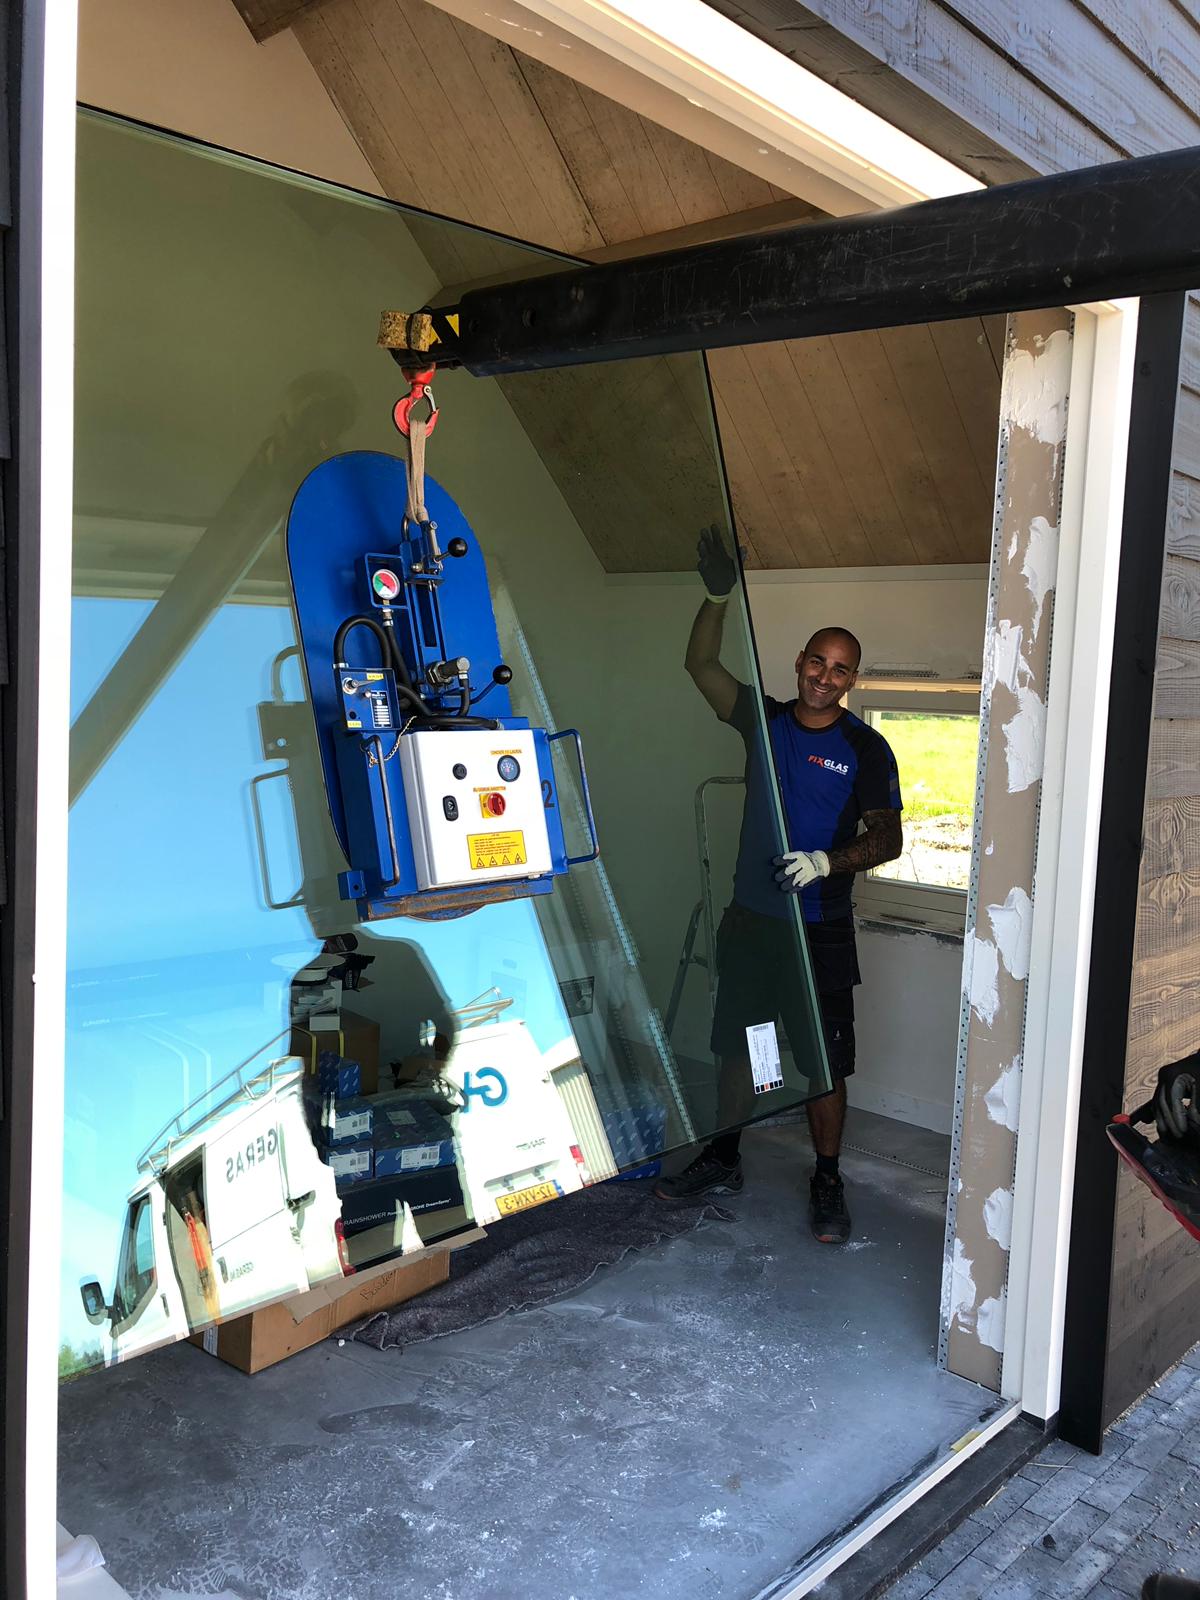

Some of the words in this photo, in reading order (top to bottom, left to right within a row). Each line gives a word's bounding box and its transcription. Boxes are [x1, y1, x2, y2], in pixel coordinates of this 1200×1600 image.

[808, 754, 849, 774] FIXGLAS
[541, 779, 555, 808] 2
[344, 1211, 386, 1228] RAINSHOWER
